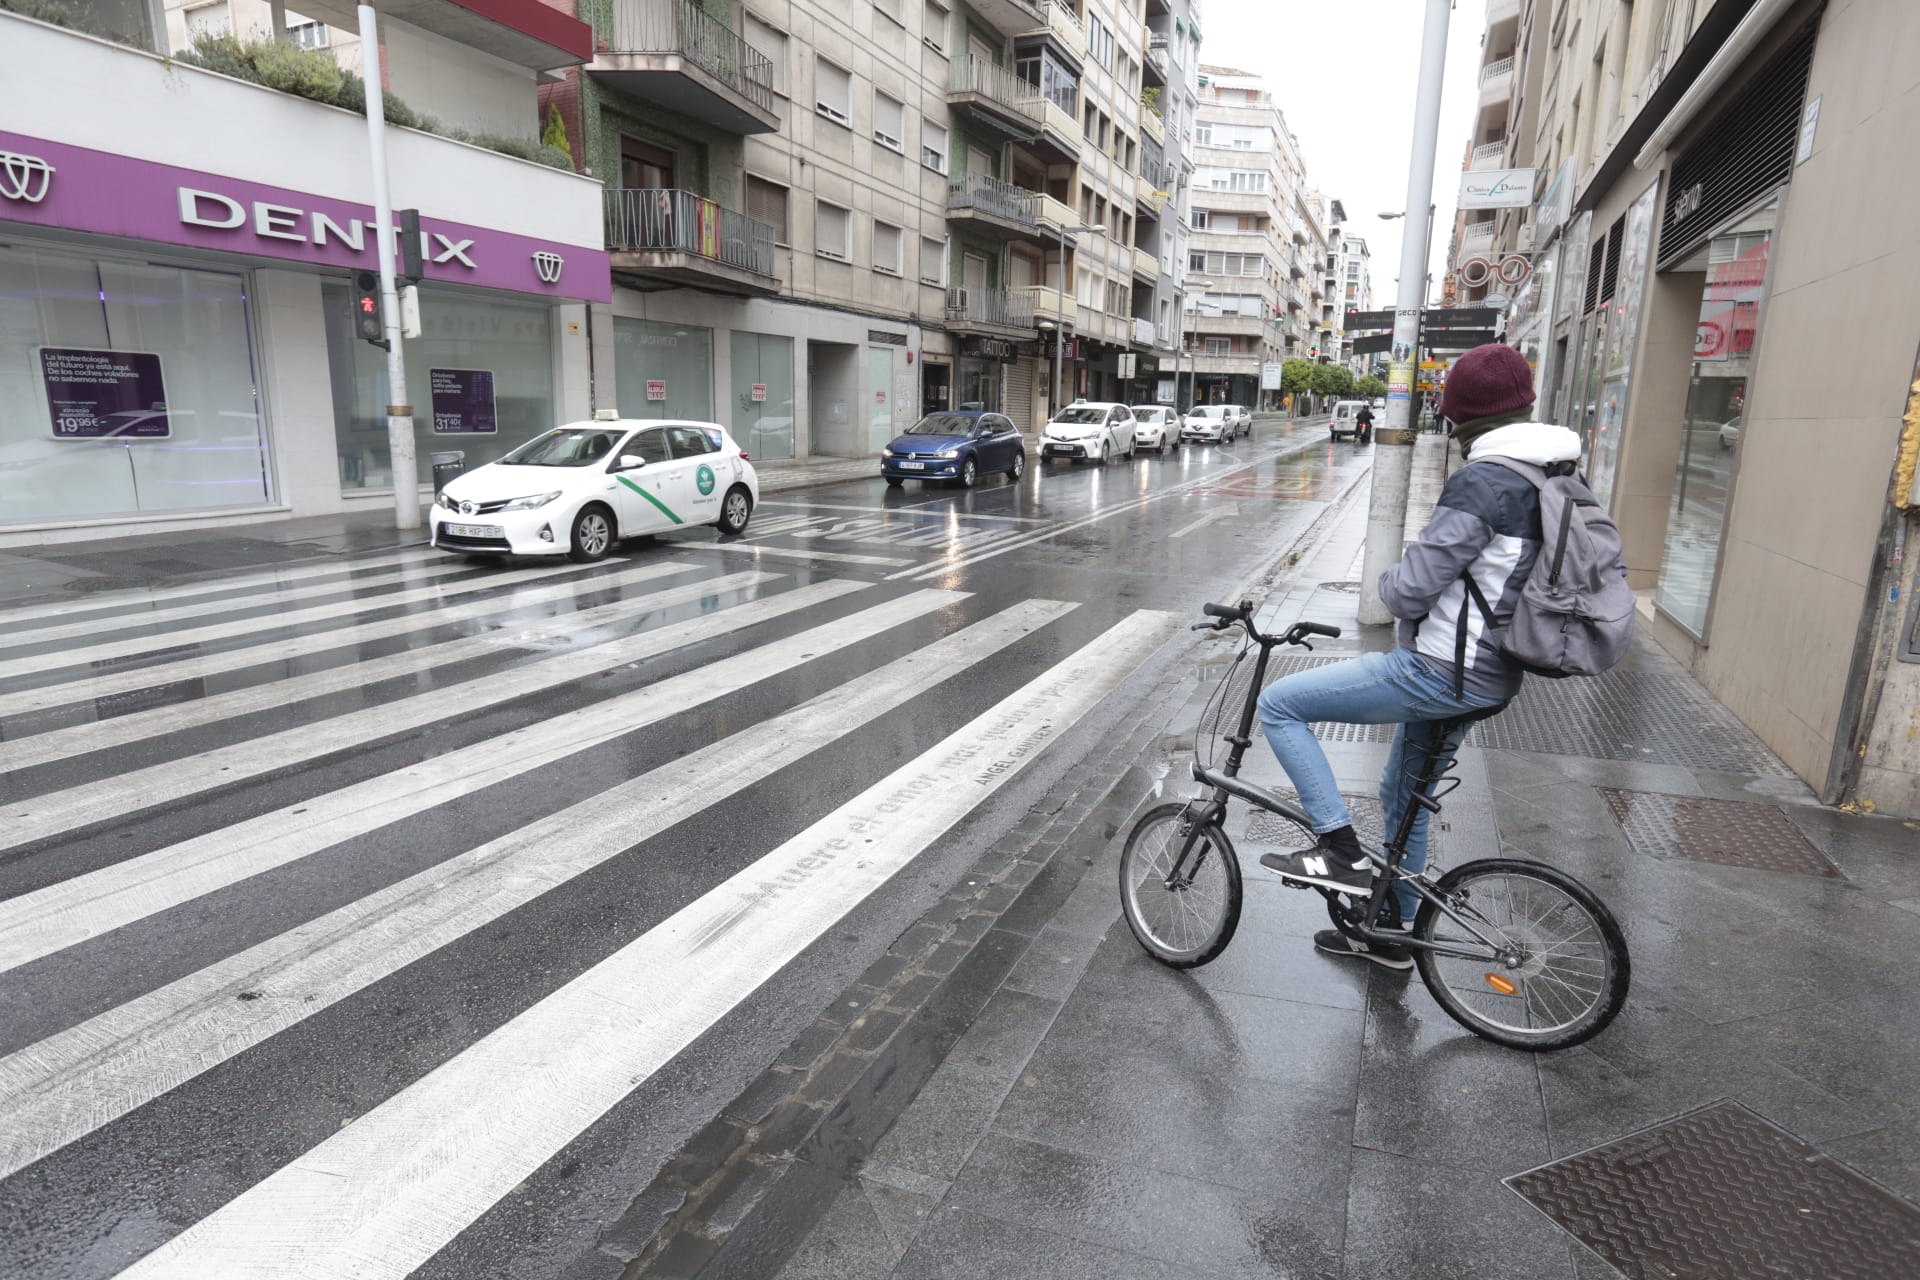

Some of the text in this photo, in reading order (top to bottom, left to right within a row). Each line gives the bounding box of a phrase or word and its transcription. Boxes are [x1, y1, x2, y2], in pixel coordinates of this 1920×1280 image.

[177, 186, 477, 269] DENTIX
[983, 339, 1010, 357] TATTOO
[974, 761, 1017, 786] ANGEL
[1302, 857, 1329, 876] N
